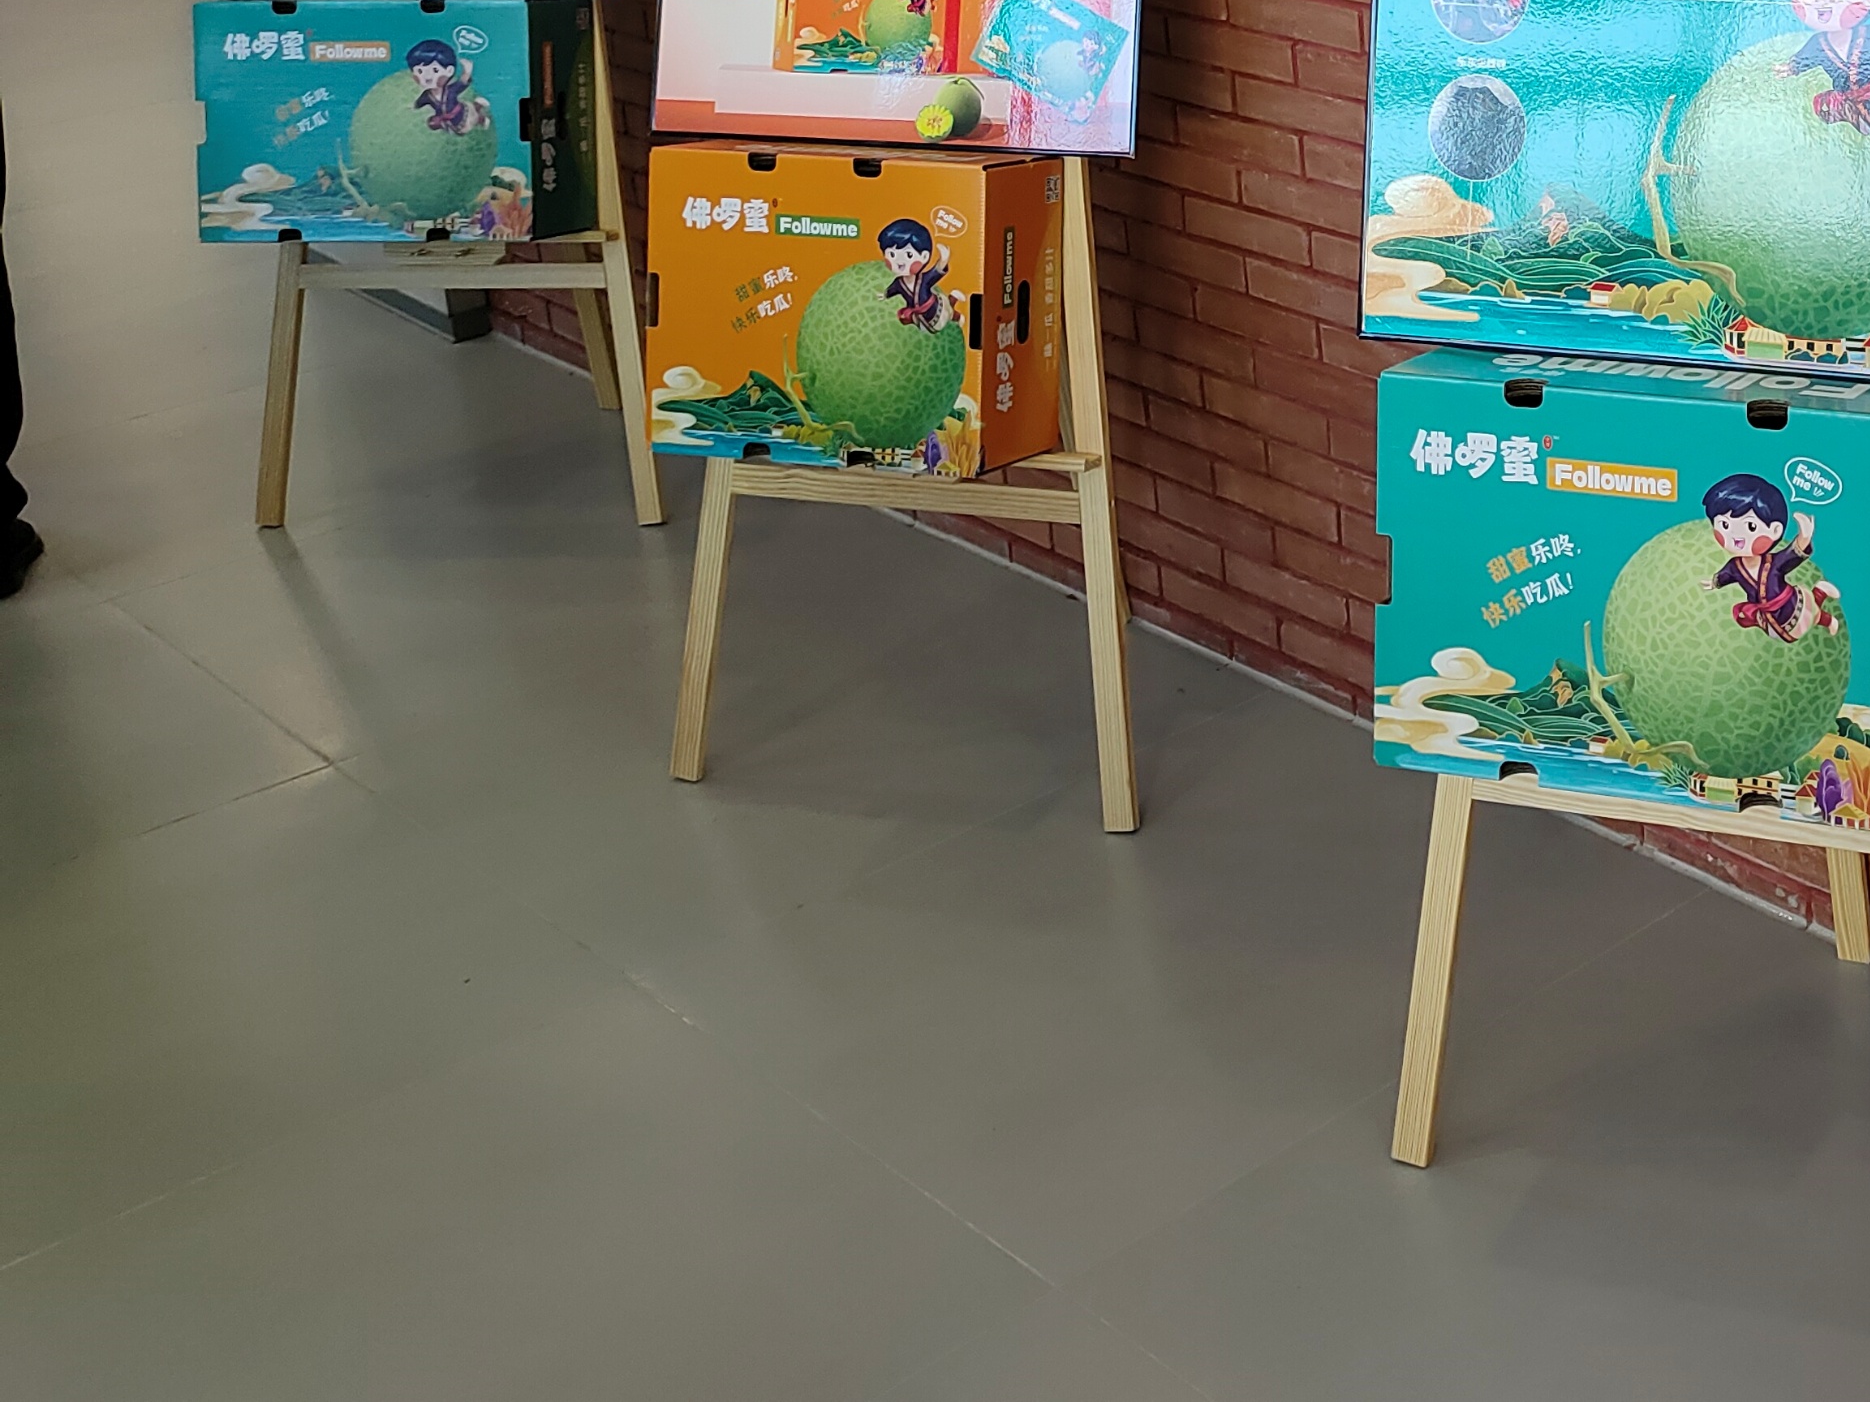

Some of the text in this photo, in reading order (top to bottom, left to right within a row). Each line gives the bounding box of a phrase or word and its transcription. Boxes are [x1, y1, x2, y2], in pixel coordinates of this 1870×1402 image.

[314, 44, 388, 59] Followme
[779, 216, 859, 238] Followme
[1554, 463, 1673, 497] Followme
[1792, 475, 1811, 491] me
[1796, 463, 1835, 491] Follow
[1480, 572, 1575, 629] 快乐吃瓜!
